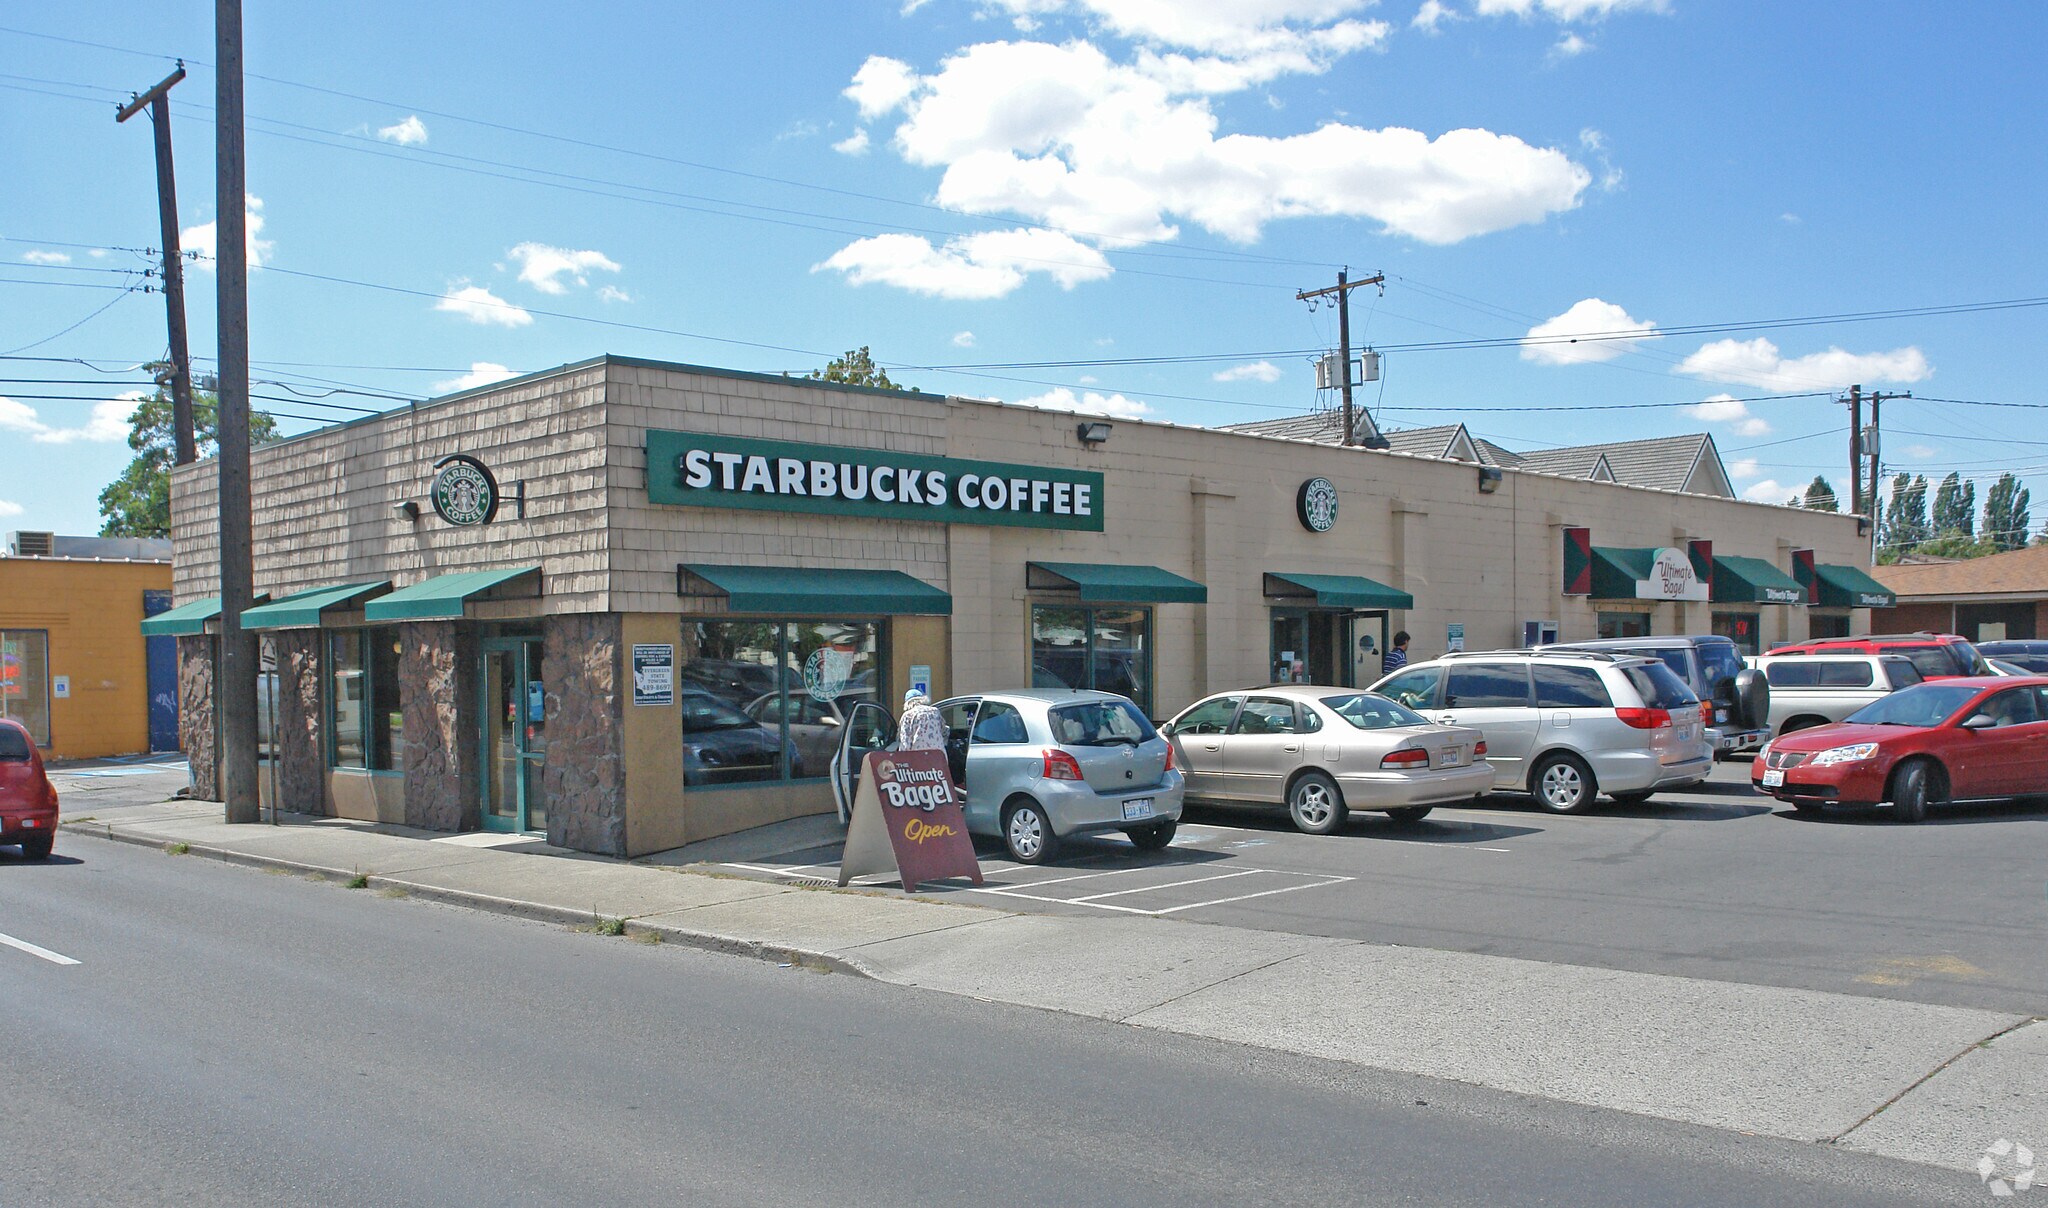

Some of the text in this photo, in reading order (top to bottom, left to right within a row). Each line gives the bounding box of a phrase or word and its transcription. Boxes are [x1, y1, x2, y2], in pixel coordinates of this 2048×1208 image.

[440, 468, 487, 494] STARBUCKS
[685, 448, 1091, 516] STARBUCKS COFFEE
[1307, 481, 1336, 505] STARBUCKS
[446, 506, 483, 522] COFFEE
[1310, 514, 1333, 529] COFFEE
[1657, 561, 1693, 580] Ultimate
[1662, 578, 1685, 598] Bagel
[811, 685, 841, 700] COFFEE
[890, 767, 946, 784] Ultimate
[880, 780, 953, 811] Bagel
[904, 818, 958, 845] Open
